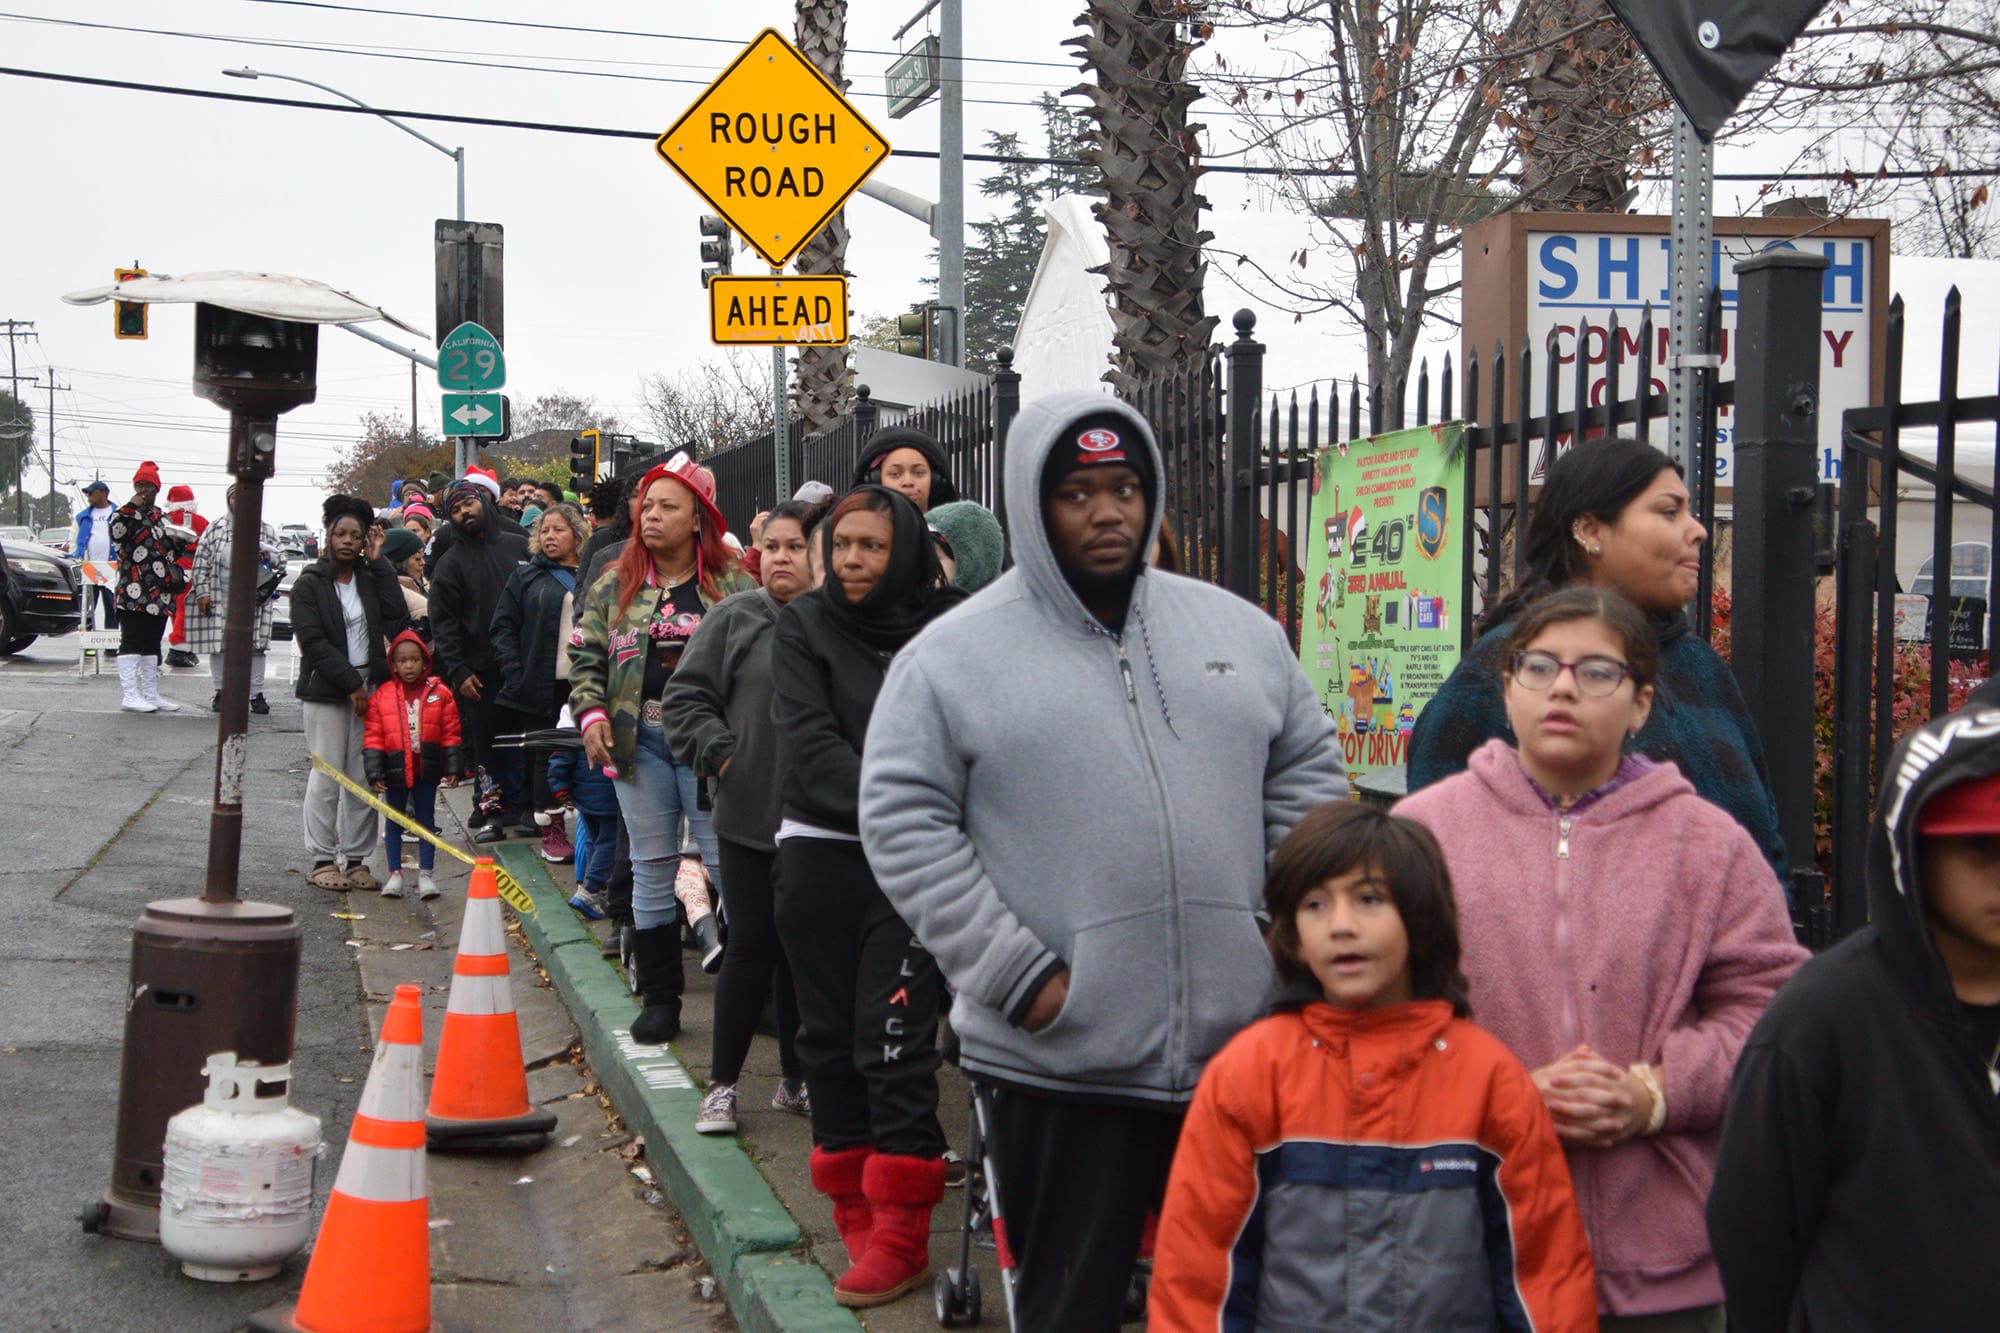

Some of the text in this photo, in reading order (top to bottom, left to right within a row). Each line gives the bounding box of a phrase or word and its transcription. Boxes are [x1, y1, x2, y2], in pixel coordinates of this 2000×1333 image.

[890, 57, 923, 100] Lemon St
[710, 112, 836, 144] ROUGH
[725, 166, 824, 197] ROAD
[727, 296, 831, 326] AHEAD
[445, 337, 495, 350] CALIFORNIA
[448, 349, 496, 380] 29
[1371, 480, 1397, 493] COMMUNITY
[1397, 478, 1416, 490] CHURCH
[1348, 571, 1407, 594] 3RD ANNUAL
[608, 626, 639, 660] Just
[1338, 731, 1366, 766] TOY
